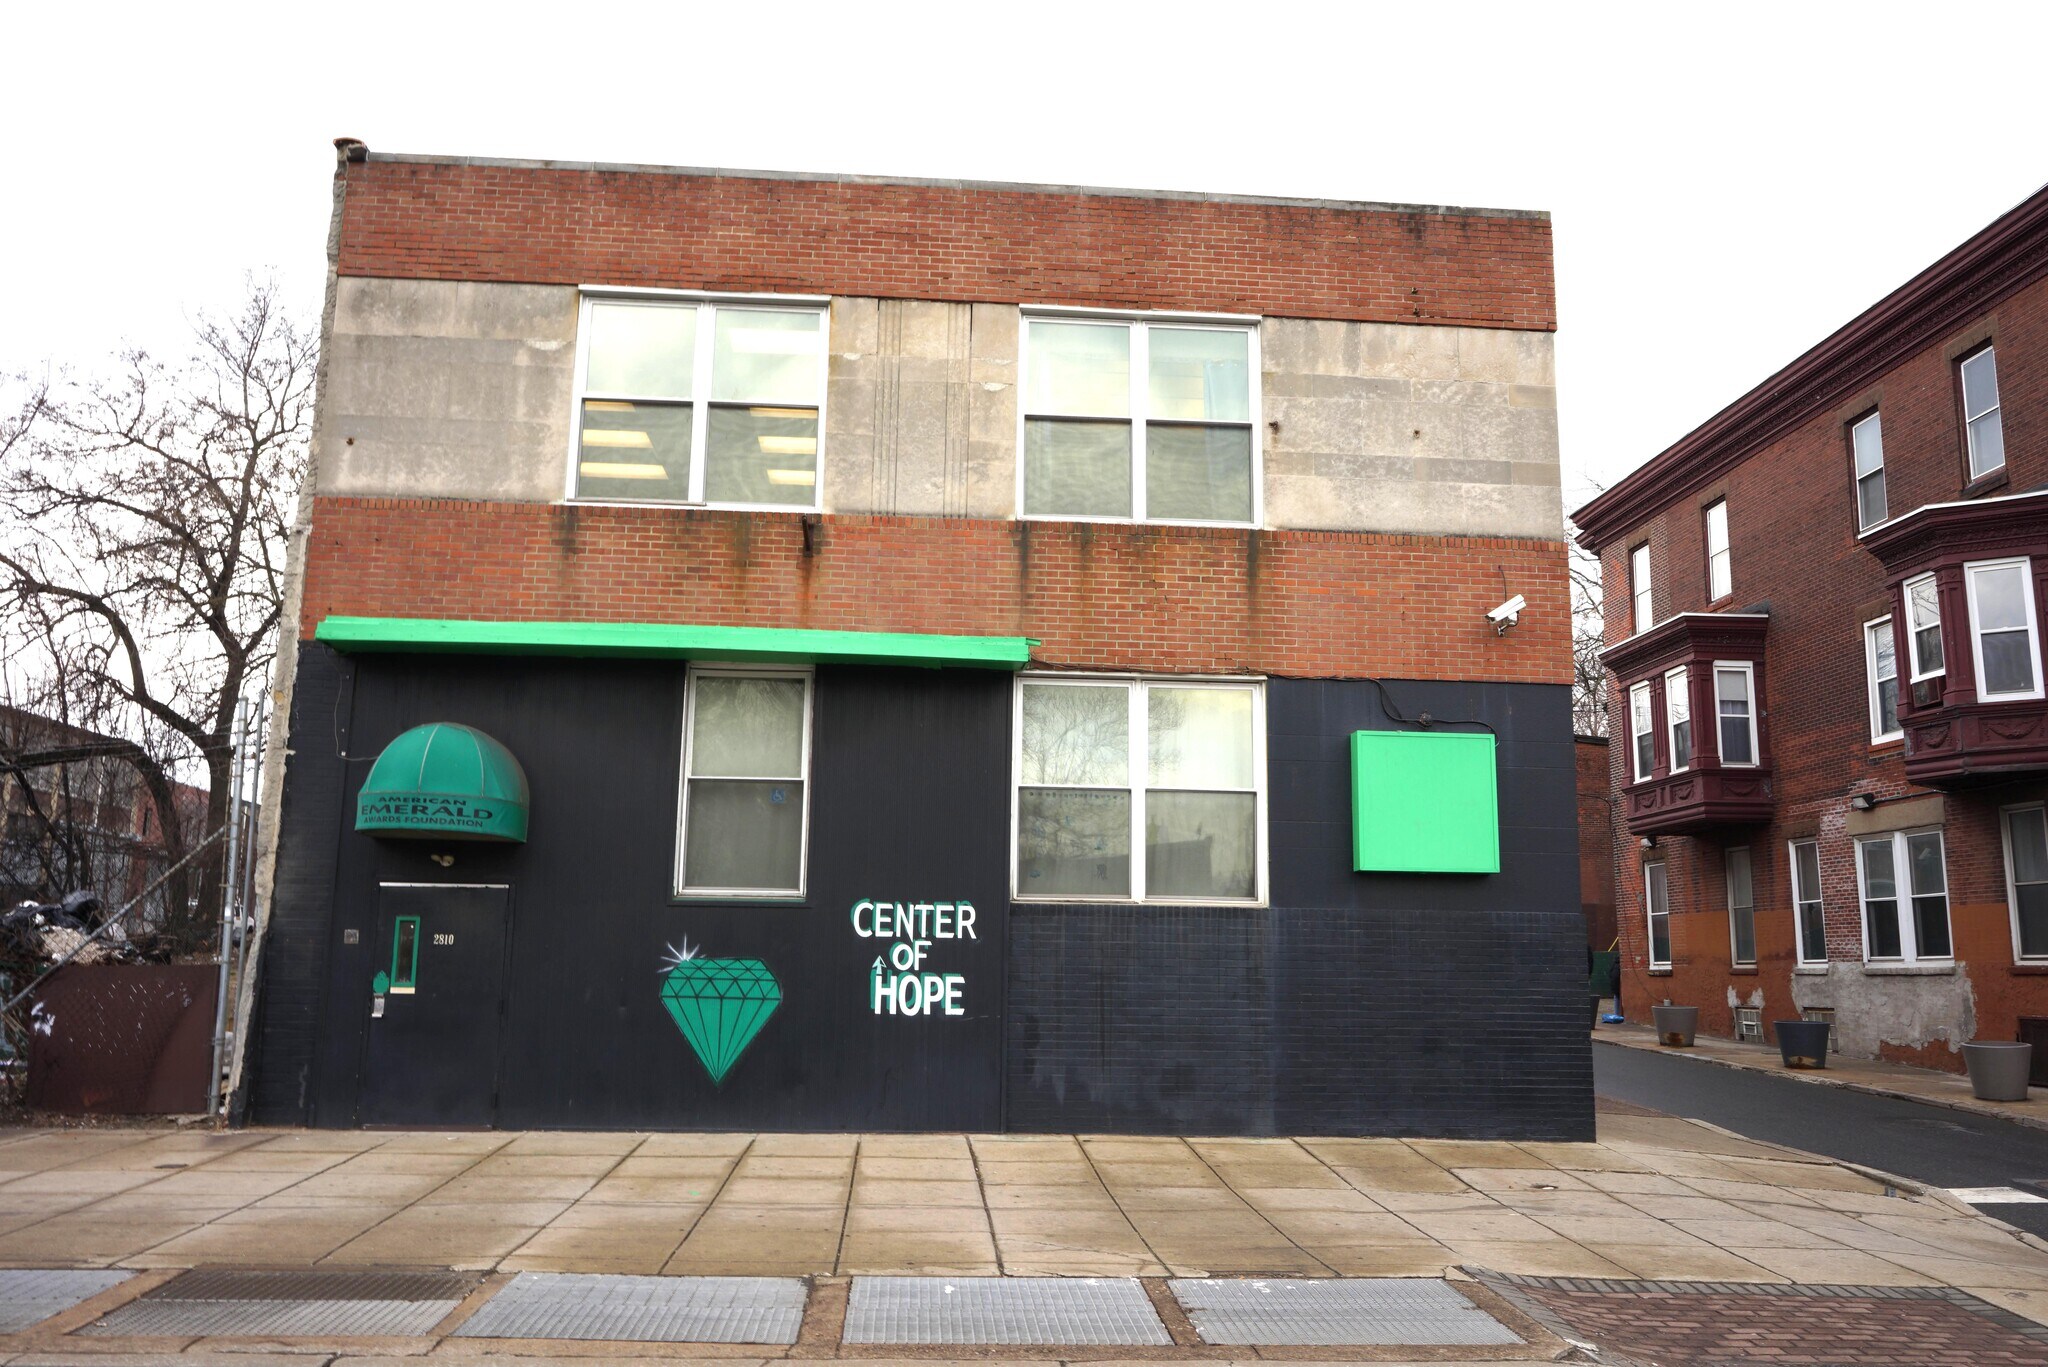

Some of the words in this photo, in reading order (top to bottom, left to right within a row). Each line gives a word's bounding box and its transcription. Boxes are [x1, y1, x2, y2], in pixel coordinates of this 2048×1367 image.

[378, 796, 466, 806] AMERICAN
[361, 804, 493, 819] EMERALD
[364, 815, 401, 824] AWARDS
[404, 816, 483, 827] FOUNDATION
[851, 900, 977, 941] CENTER
[433, 933, 454, 945] 2810
[891, 940, 933, 971] OF
[872, 972, 966, 1016] HOPE
